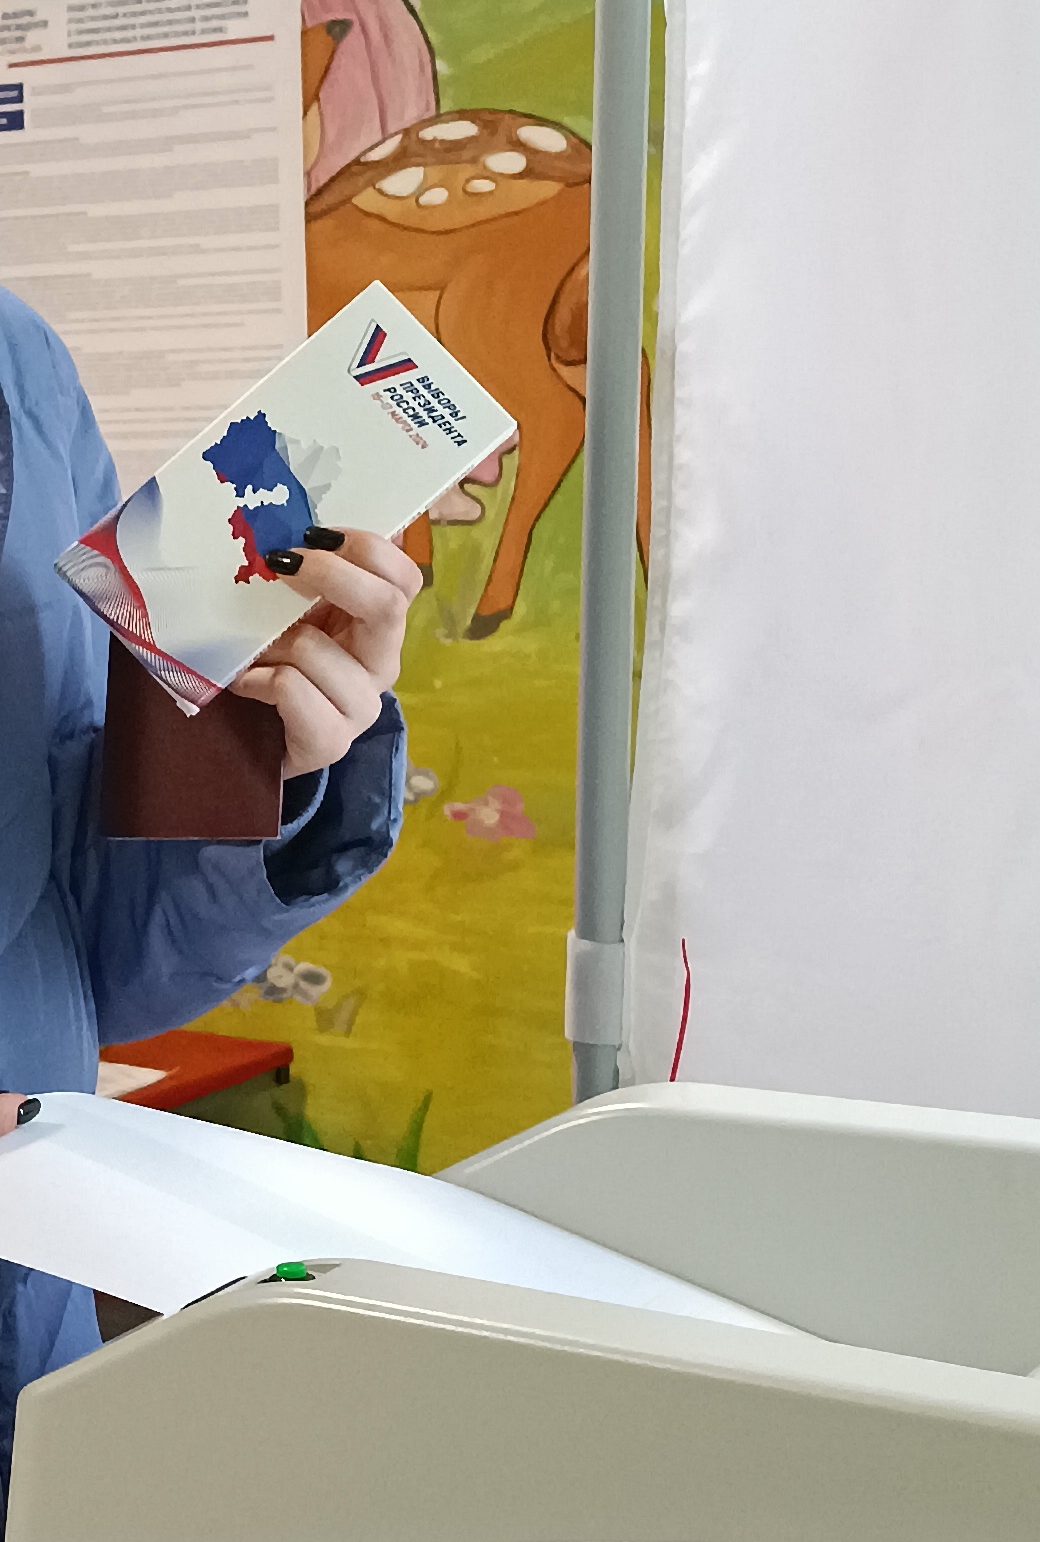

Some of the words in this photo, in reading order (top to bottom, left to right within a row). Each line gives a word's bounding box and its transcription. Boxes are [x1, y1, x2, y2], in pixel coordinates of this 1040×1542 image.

[383, 386, 430, 428] РОССИИ
[399, 380, 468, 448] ПРЕЗИДЕНТА
[416, 375, 467, 422] ВЫБОРЫ
